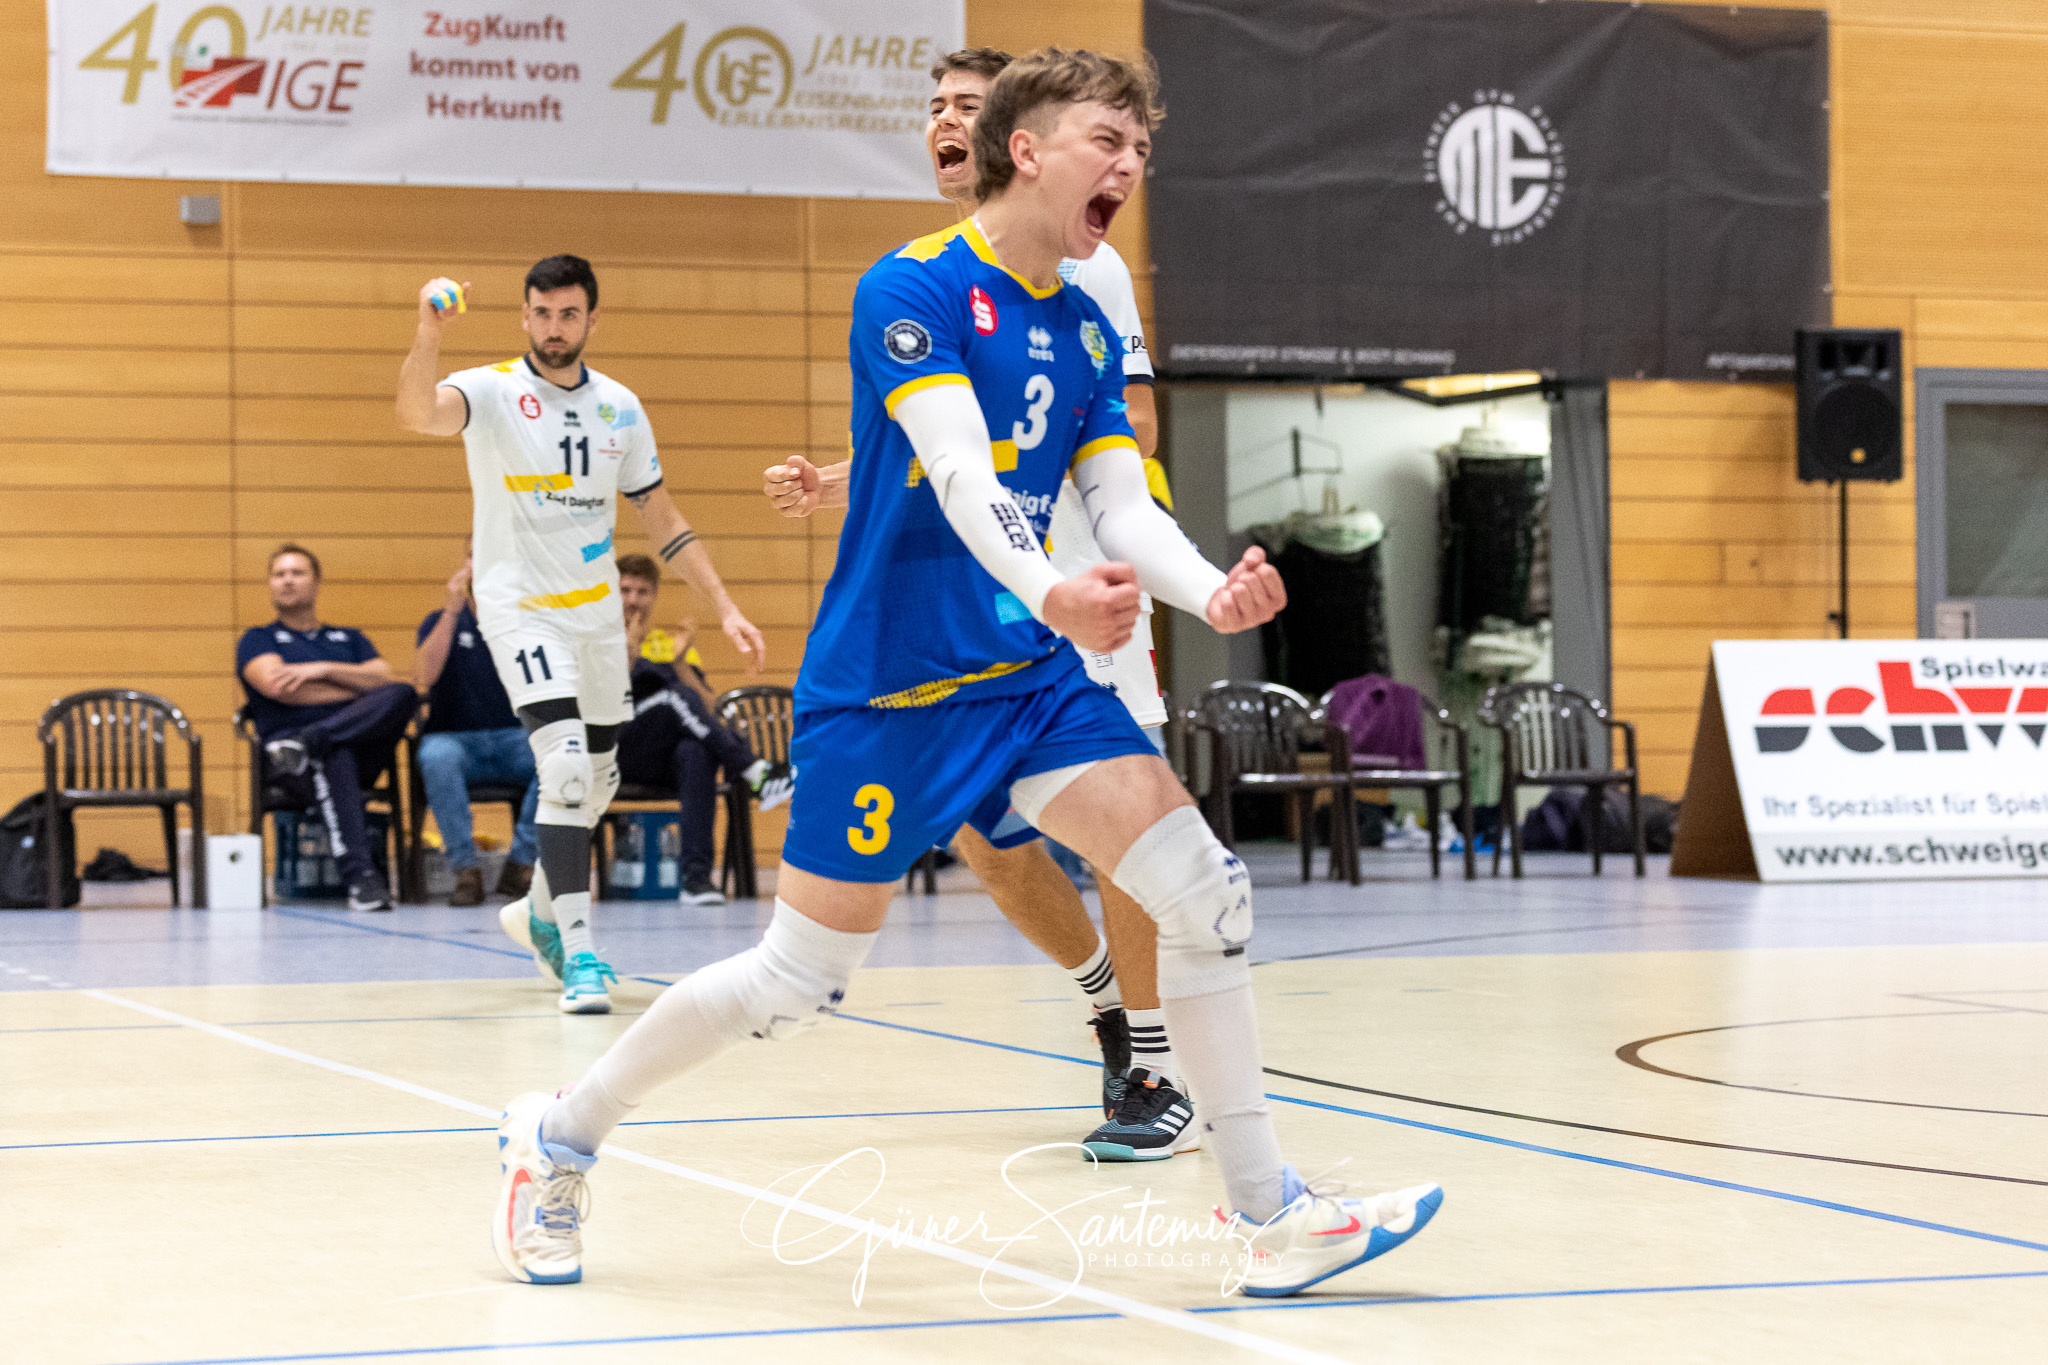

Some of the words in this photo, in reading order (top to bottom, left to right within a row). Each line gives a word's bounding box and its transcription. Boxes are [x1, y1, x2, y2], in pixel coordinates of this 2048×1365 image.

[255, 5, 375, 41] JAHRE
[424, 11, 566, 46] ZugKunft
[408, 50, 517, 80] kommt
[524, 60, 580, 82] von
[803, 33, 932, 76] JAHRE
[266, 58, 366, 113] IGE
[427, 92, 563, 122] Herkunft
[1012, 374, 1055, 450] 3
[558, 435, 589, 476] 11
[515, 645, 552, 684] 11
[847, 783, 895, 855] 3
[1763, 795, 1797, 816] Ihr
[1808, 794, 1935, 819] Spezialist
[1942, 792, 1976, 815] für
